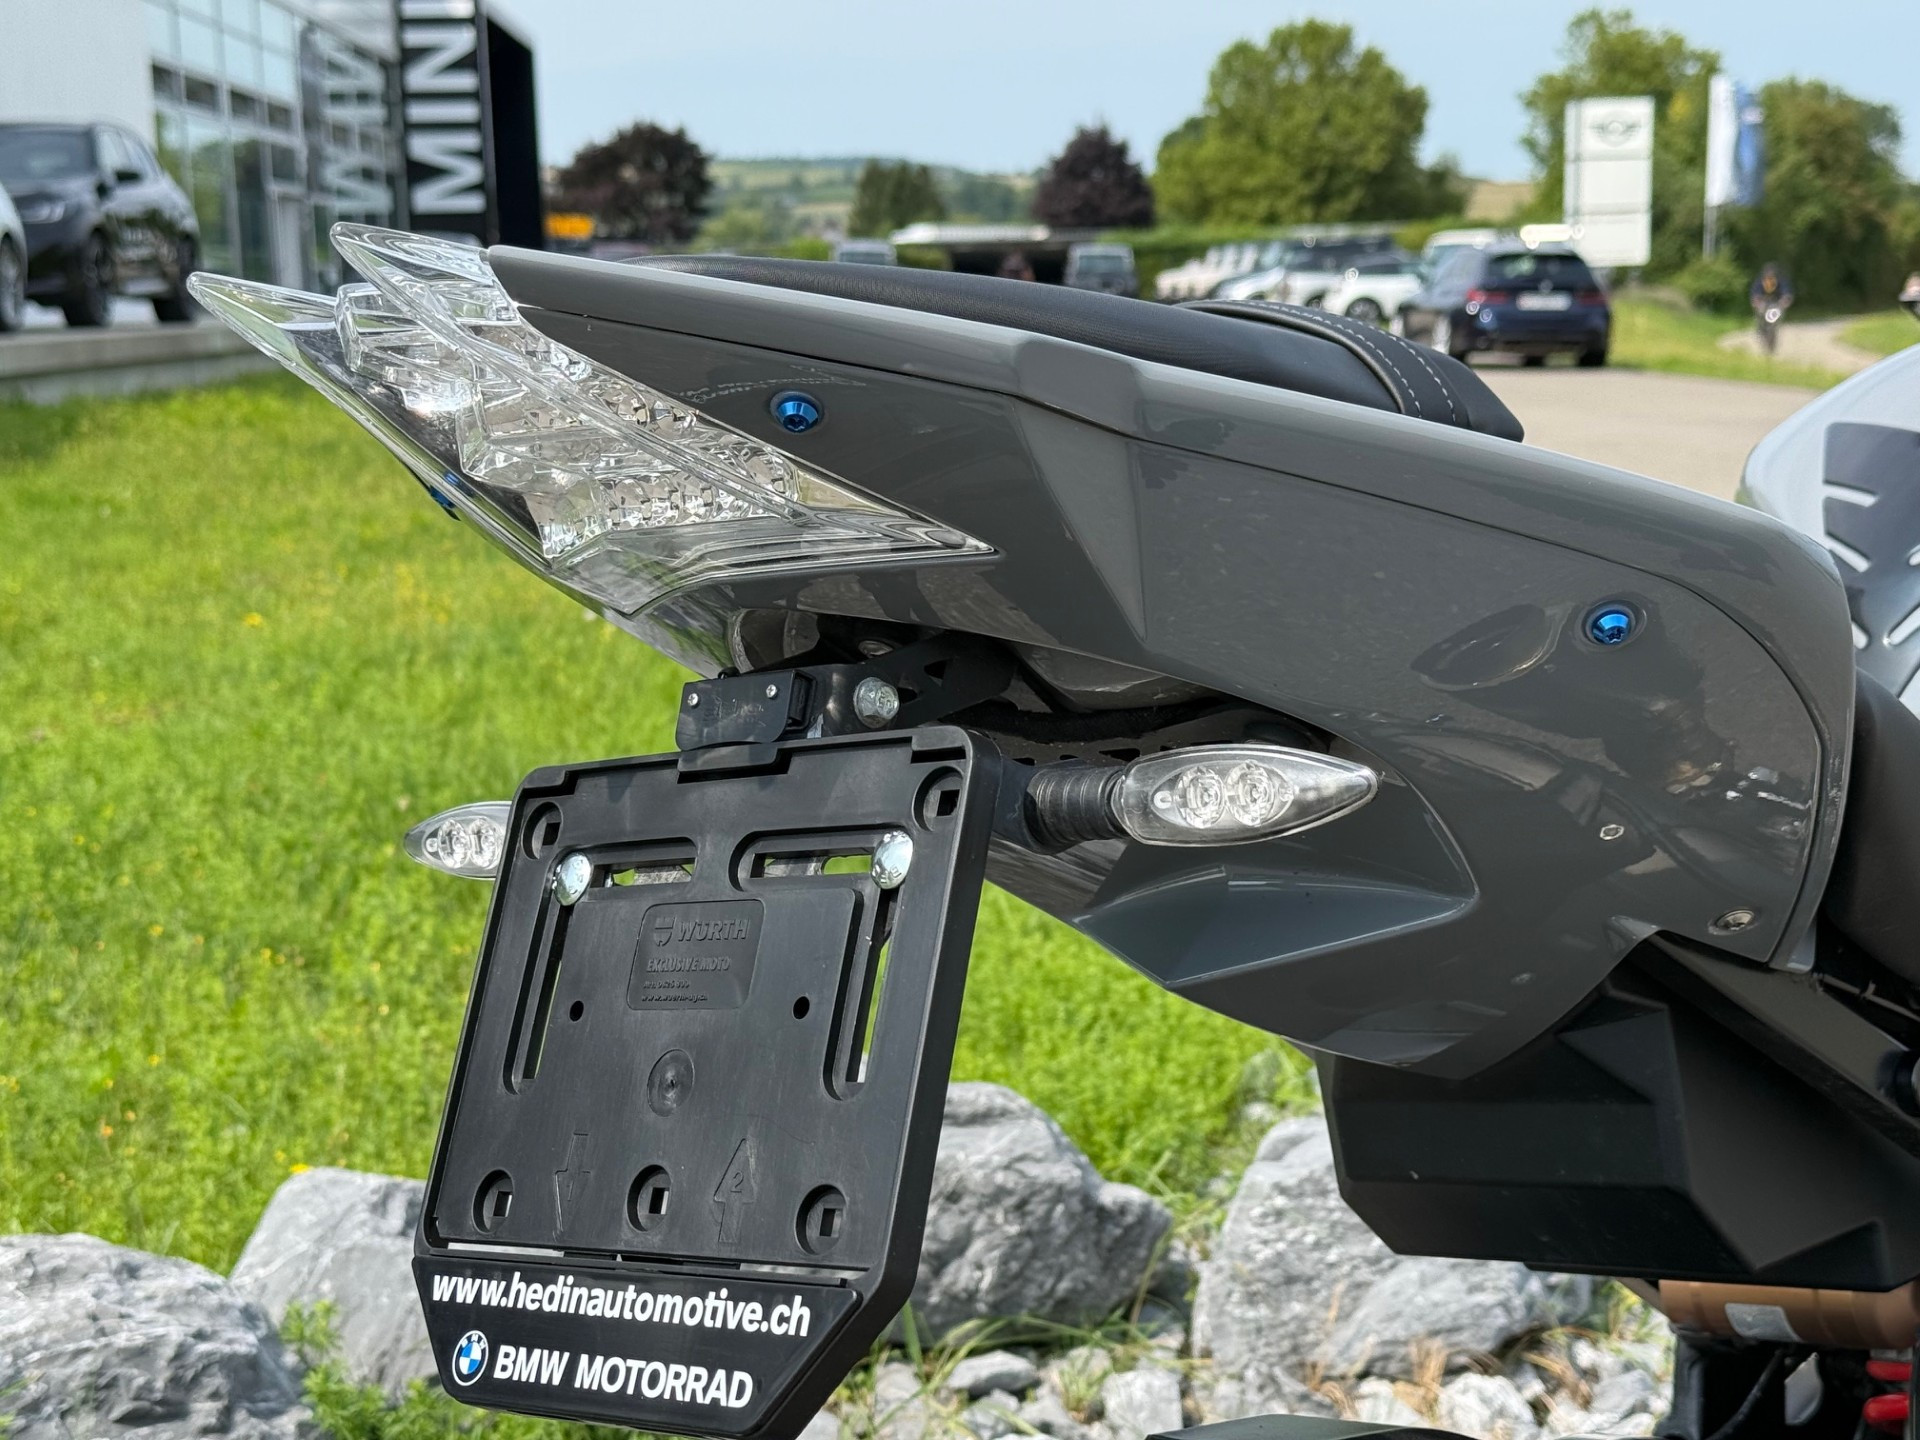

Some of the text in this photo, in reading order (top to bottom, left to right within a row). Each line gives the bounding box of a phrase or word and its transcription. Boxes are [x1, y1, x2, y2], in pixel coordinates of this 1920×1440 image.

[646, 955, 732, 973] EXCLUSIVE MOTO
[730, 1170, 745, 1194] 2
[432, 1271, 811, 1338] www.hedinautomotive.ch
[493, 1344, 754, 1409] BMW MOTORRAD
